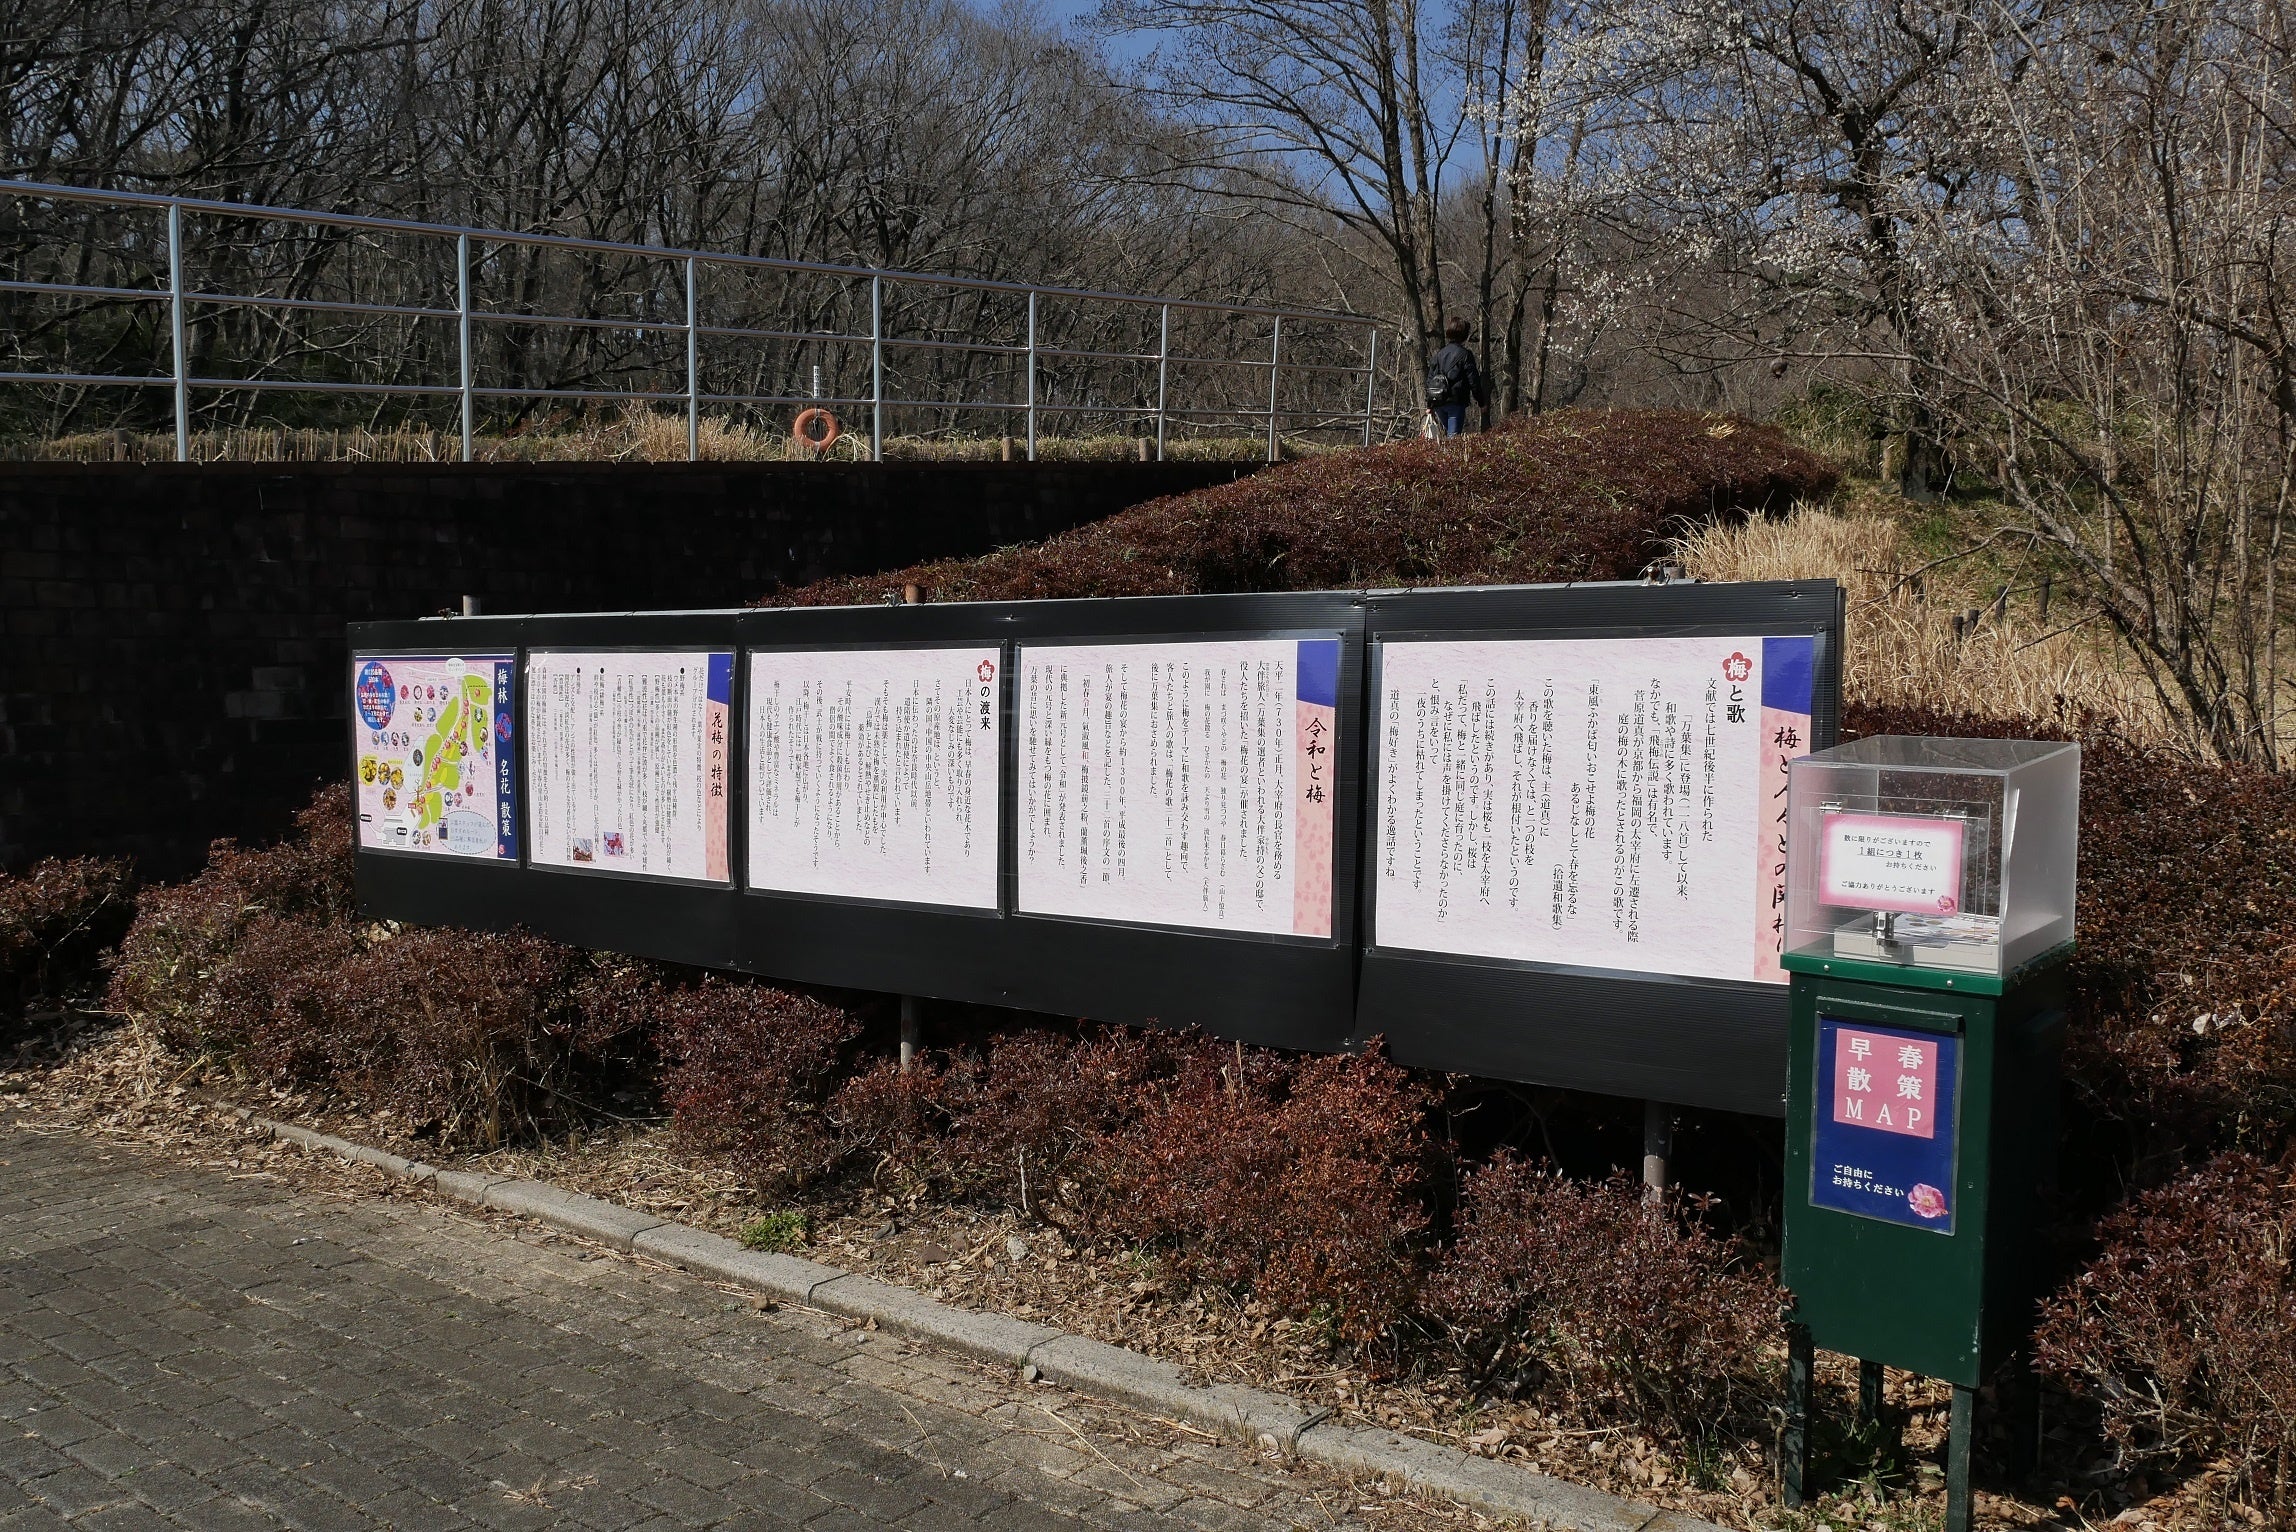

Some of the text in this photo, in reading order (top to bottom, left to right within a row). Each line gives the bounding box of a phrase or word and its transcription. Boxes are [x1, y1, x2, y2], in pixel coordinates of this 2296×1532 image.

[980, 664, 991, 731] 梅の渡来
[1726, 658, 1747, 724] 梅と歌
[497, 669, 512, 836] 梅林 名花 散策
[711, 712, 723, 797] 花梅の特徴
[1305, 717, 1327, 804] 令和と梅
[1661, 701, 1677, 865] 和歌や詩に多く歌われています。
[1702, 677, 1717, 842] 文献では七世紀後半に作られた
[1844, 834, 1931, 848] 数に限りがございますので
[1885, 861, 1937, 872] お持ちください
[1841, 880, 1936, 895] ご協力ありがとうございます
[1845, 1096, 1922, 1130] MAP
[1832, 1175, 1905, 1198] お持ちください
[1833, 1164, 1873, 1180] ご自由に
